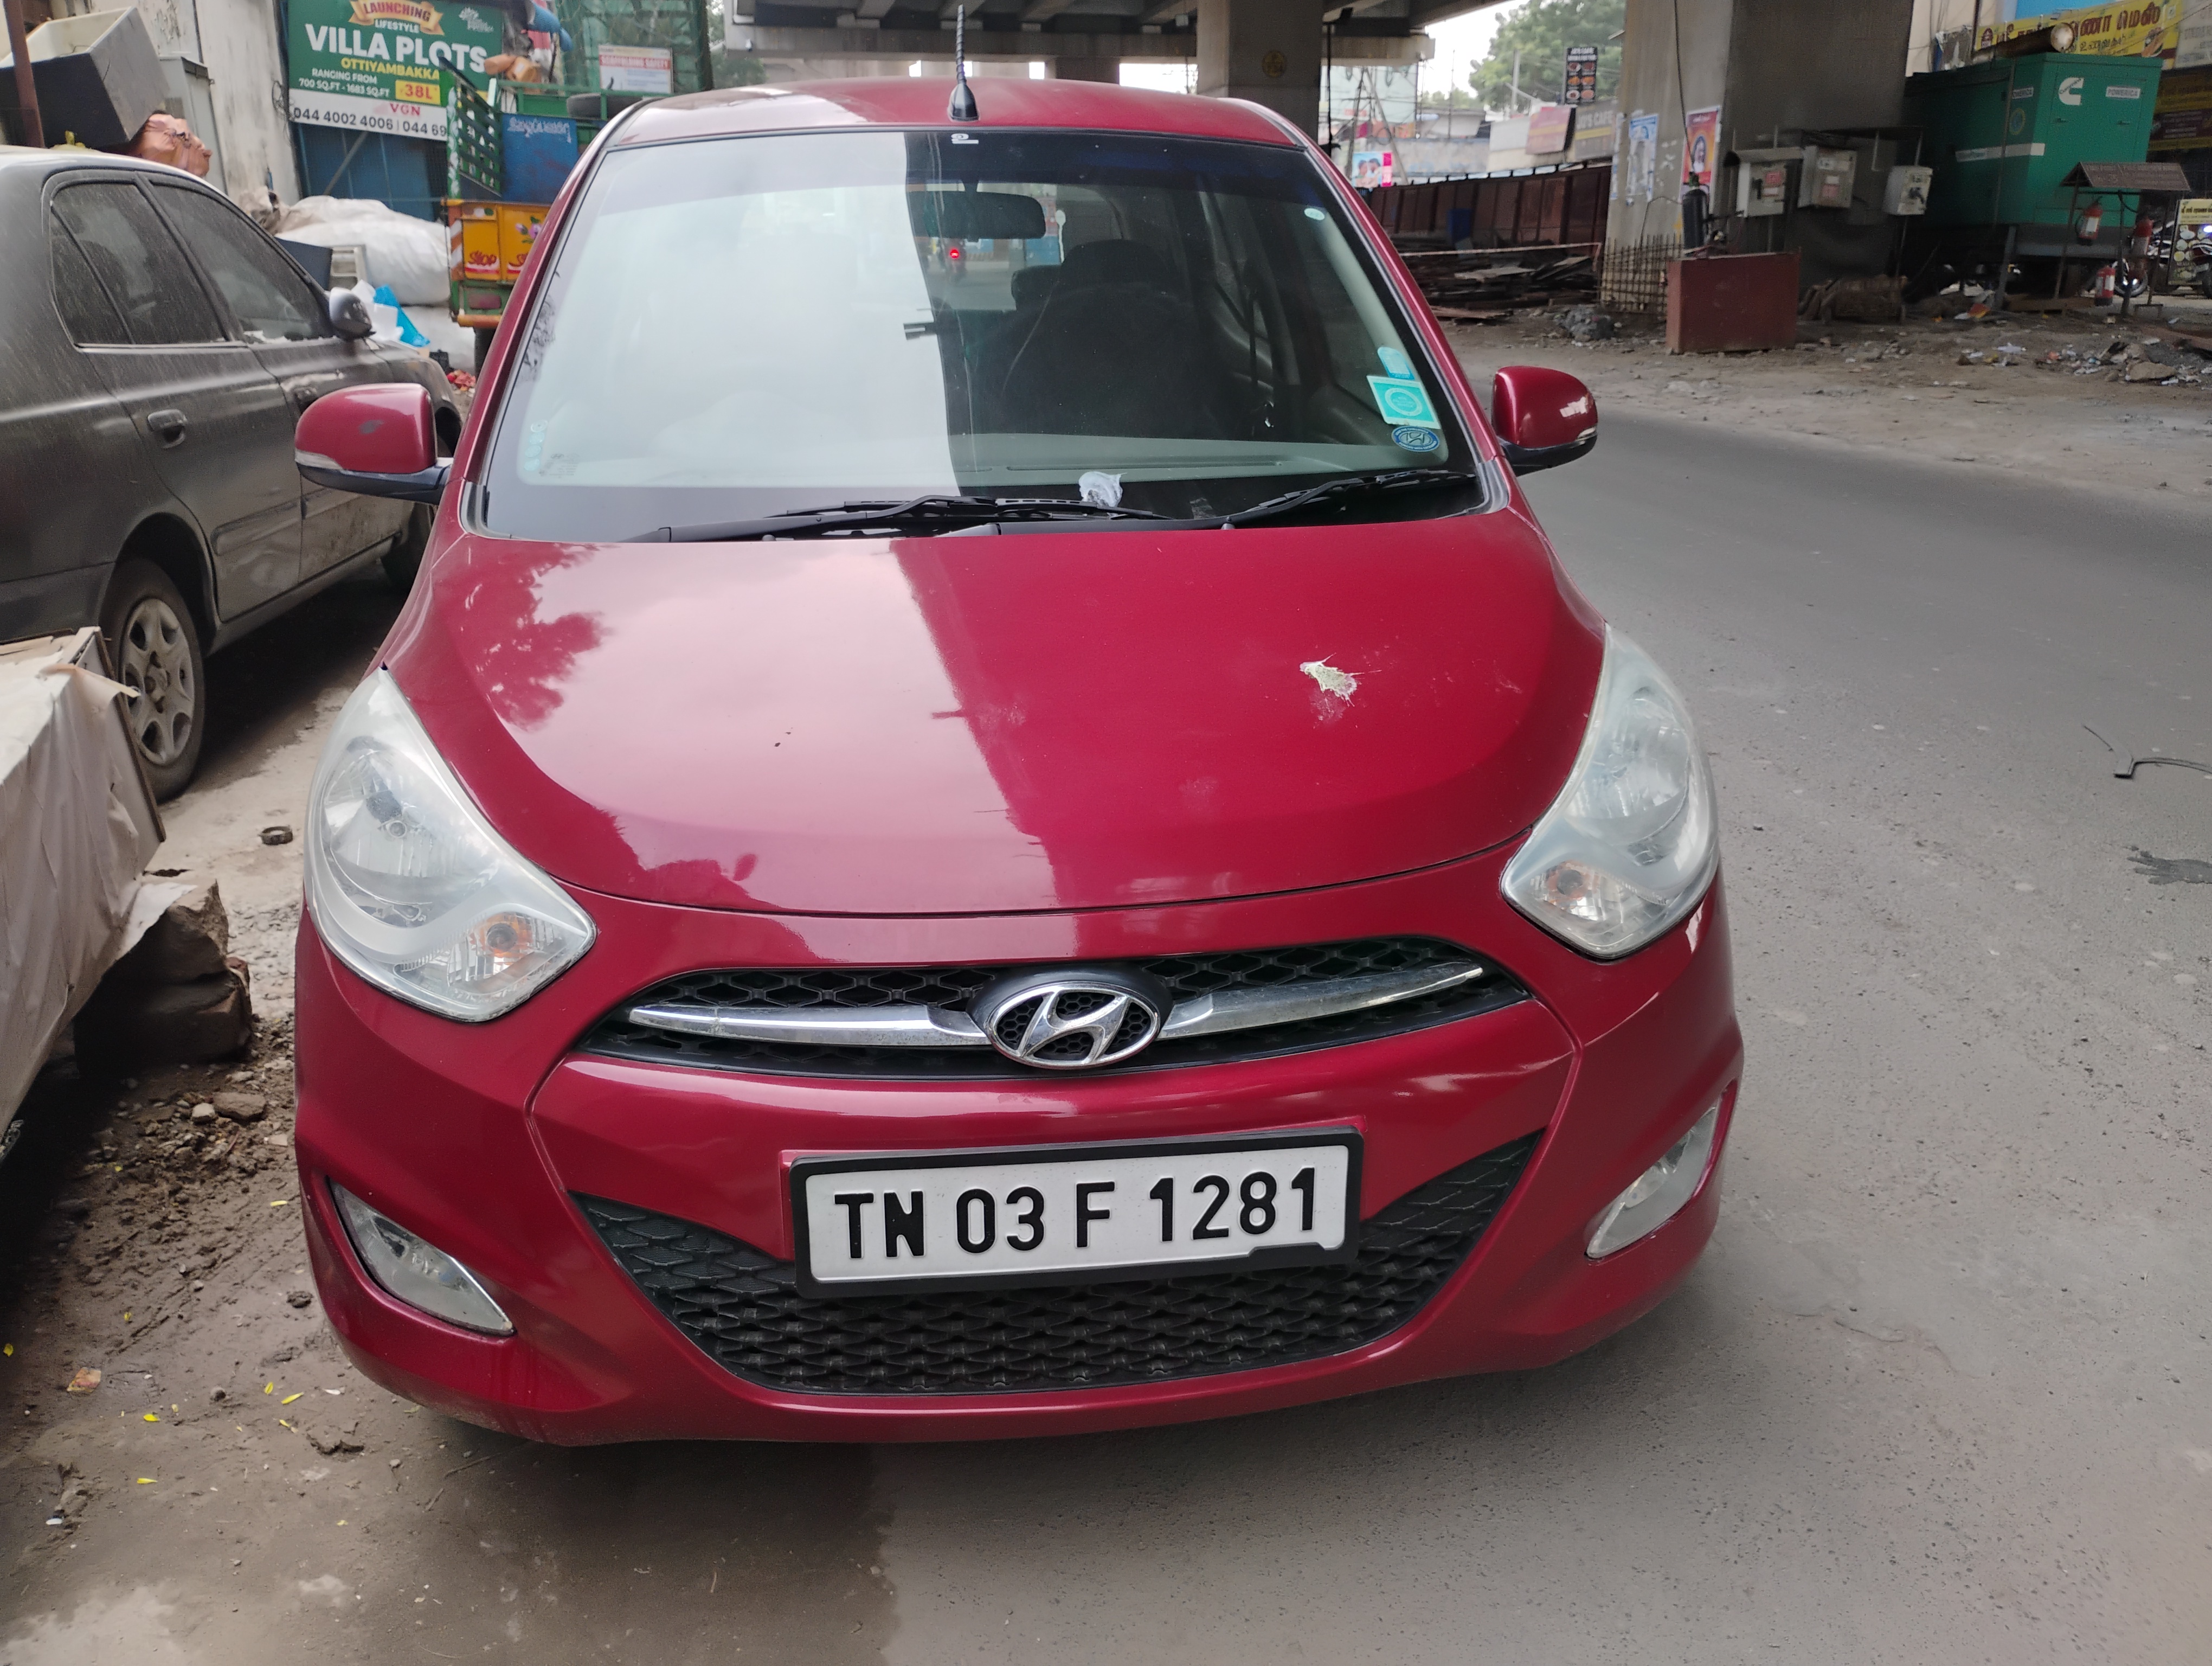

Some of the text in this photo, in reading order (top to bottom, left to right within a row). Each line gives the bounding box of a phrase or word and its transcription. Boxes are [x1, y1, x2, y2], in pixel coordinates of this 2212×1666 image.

[363, 1, 432, 22] LAUNCHING
[375, 19, 420, 33] LIFESTYLE
[305, 24, 487, 73] VILLA PLOTS
[312, 68, 377, 85] RANGING FROM
[341, 57, 440, 80] OTTIYAMBAKKA
[299, 78, 315, 87] 700
[390, 103, 421, 116] VGN
[293, 107, 319, 121] 044
[323, 111, 357, 126] 4002
[360, 115, 394, 131] 4006
[403, 121, 428, 134] 044
[834, 1167, 1316, 1259] TN 03 F 1281
